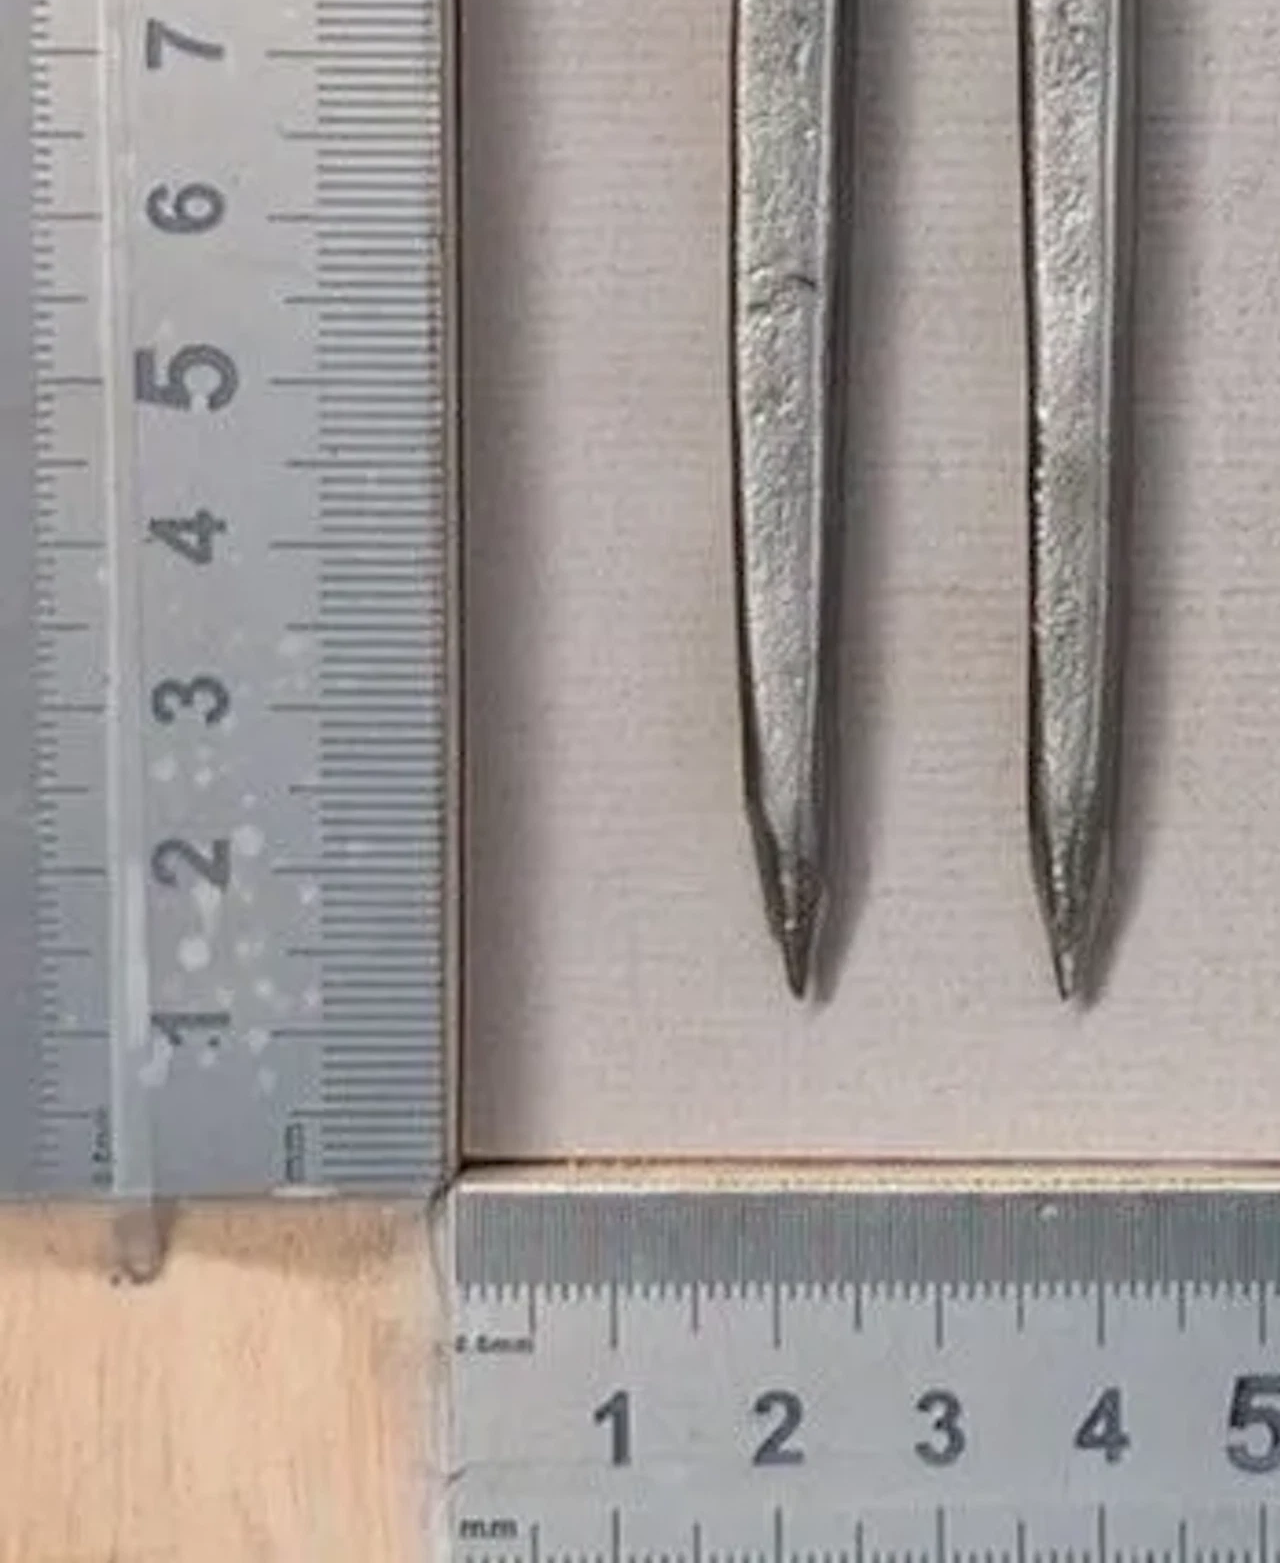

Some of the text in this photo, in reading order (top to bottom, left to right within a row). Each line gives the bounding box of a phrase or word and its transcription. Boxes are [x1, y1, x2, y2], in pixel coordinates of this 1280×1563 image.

[145, 18, 224, 70] 7
[146, 183, 225, 235] 6
[134, 344, 239, 411] 5
[148, 509, 228, 565] 4
[152, 675, 230, 726] 3
[152, 837, 231, 889] 2
[152, 1013, 230, 1046] 1
[594, 1391, 632, 1465] 1
[752, 1389, 805, 1466] 2
[914, 1389, 966, 1465] 3
[1074, 1387, 1130, 1464] 4
